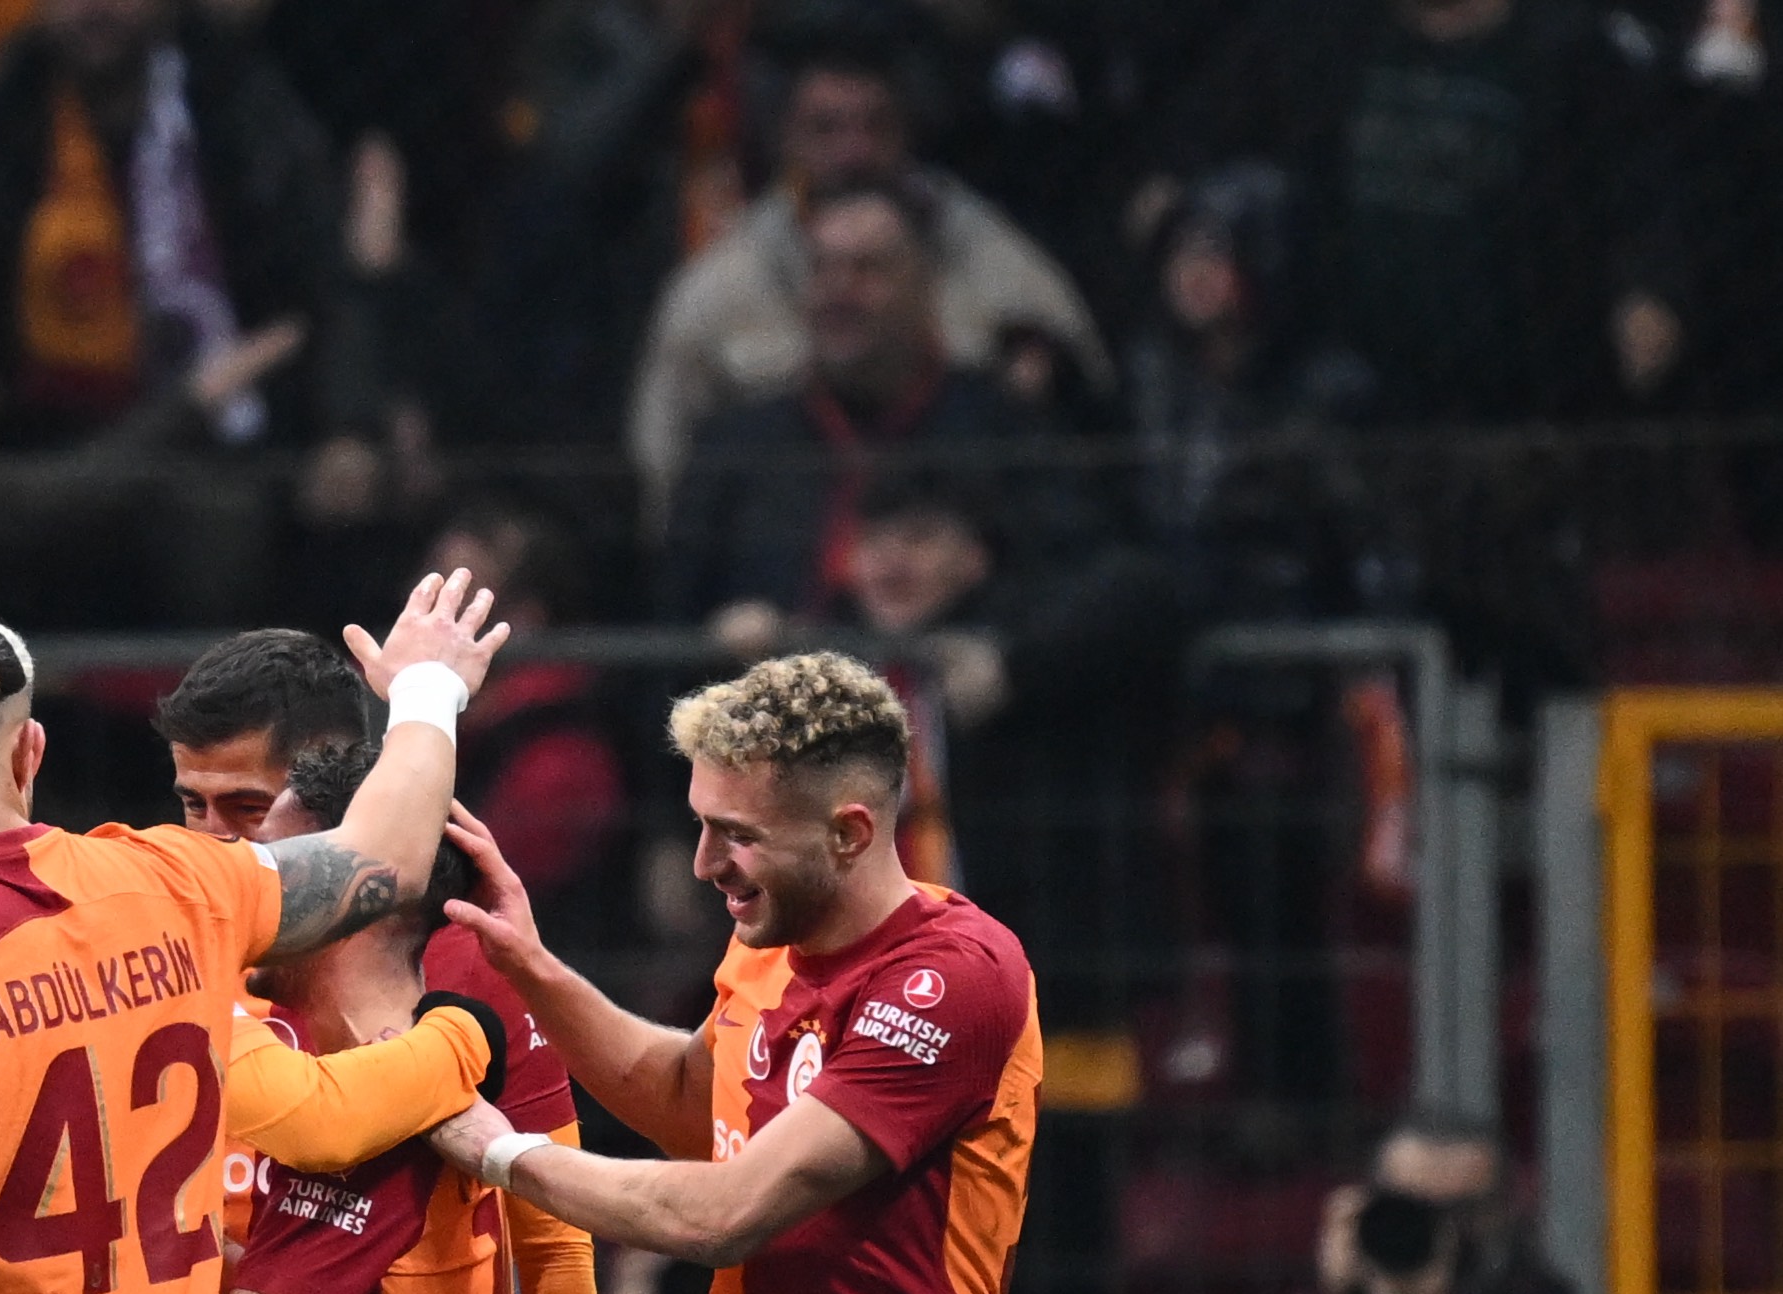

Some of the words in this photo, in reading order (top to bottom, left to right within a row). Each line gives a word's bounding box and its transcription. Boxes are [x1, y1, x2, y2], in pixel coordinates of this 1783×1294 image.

[852, 1015, 940, 1066] AIRLINES
[864, 1000, 952, 1049] TURKISH
[277, 1196, 367, 1236] AIRLINES
[288, 1177, 373, 1217] TURKISH
